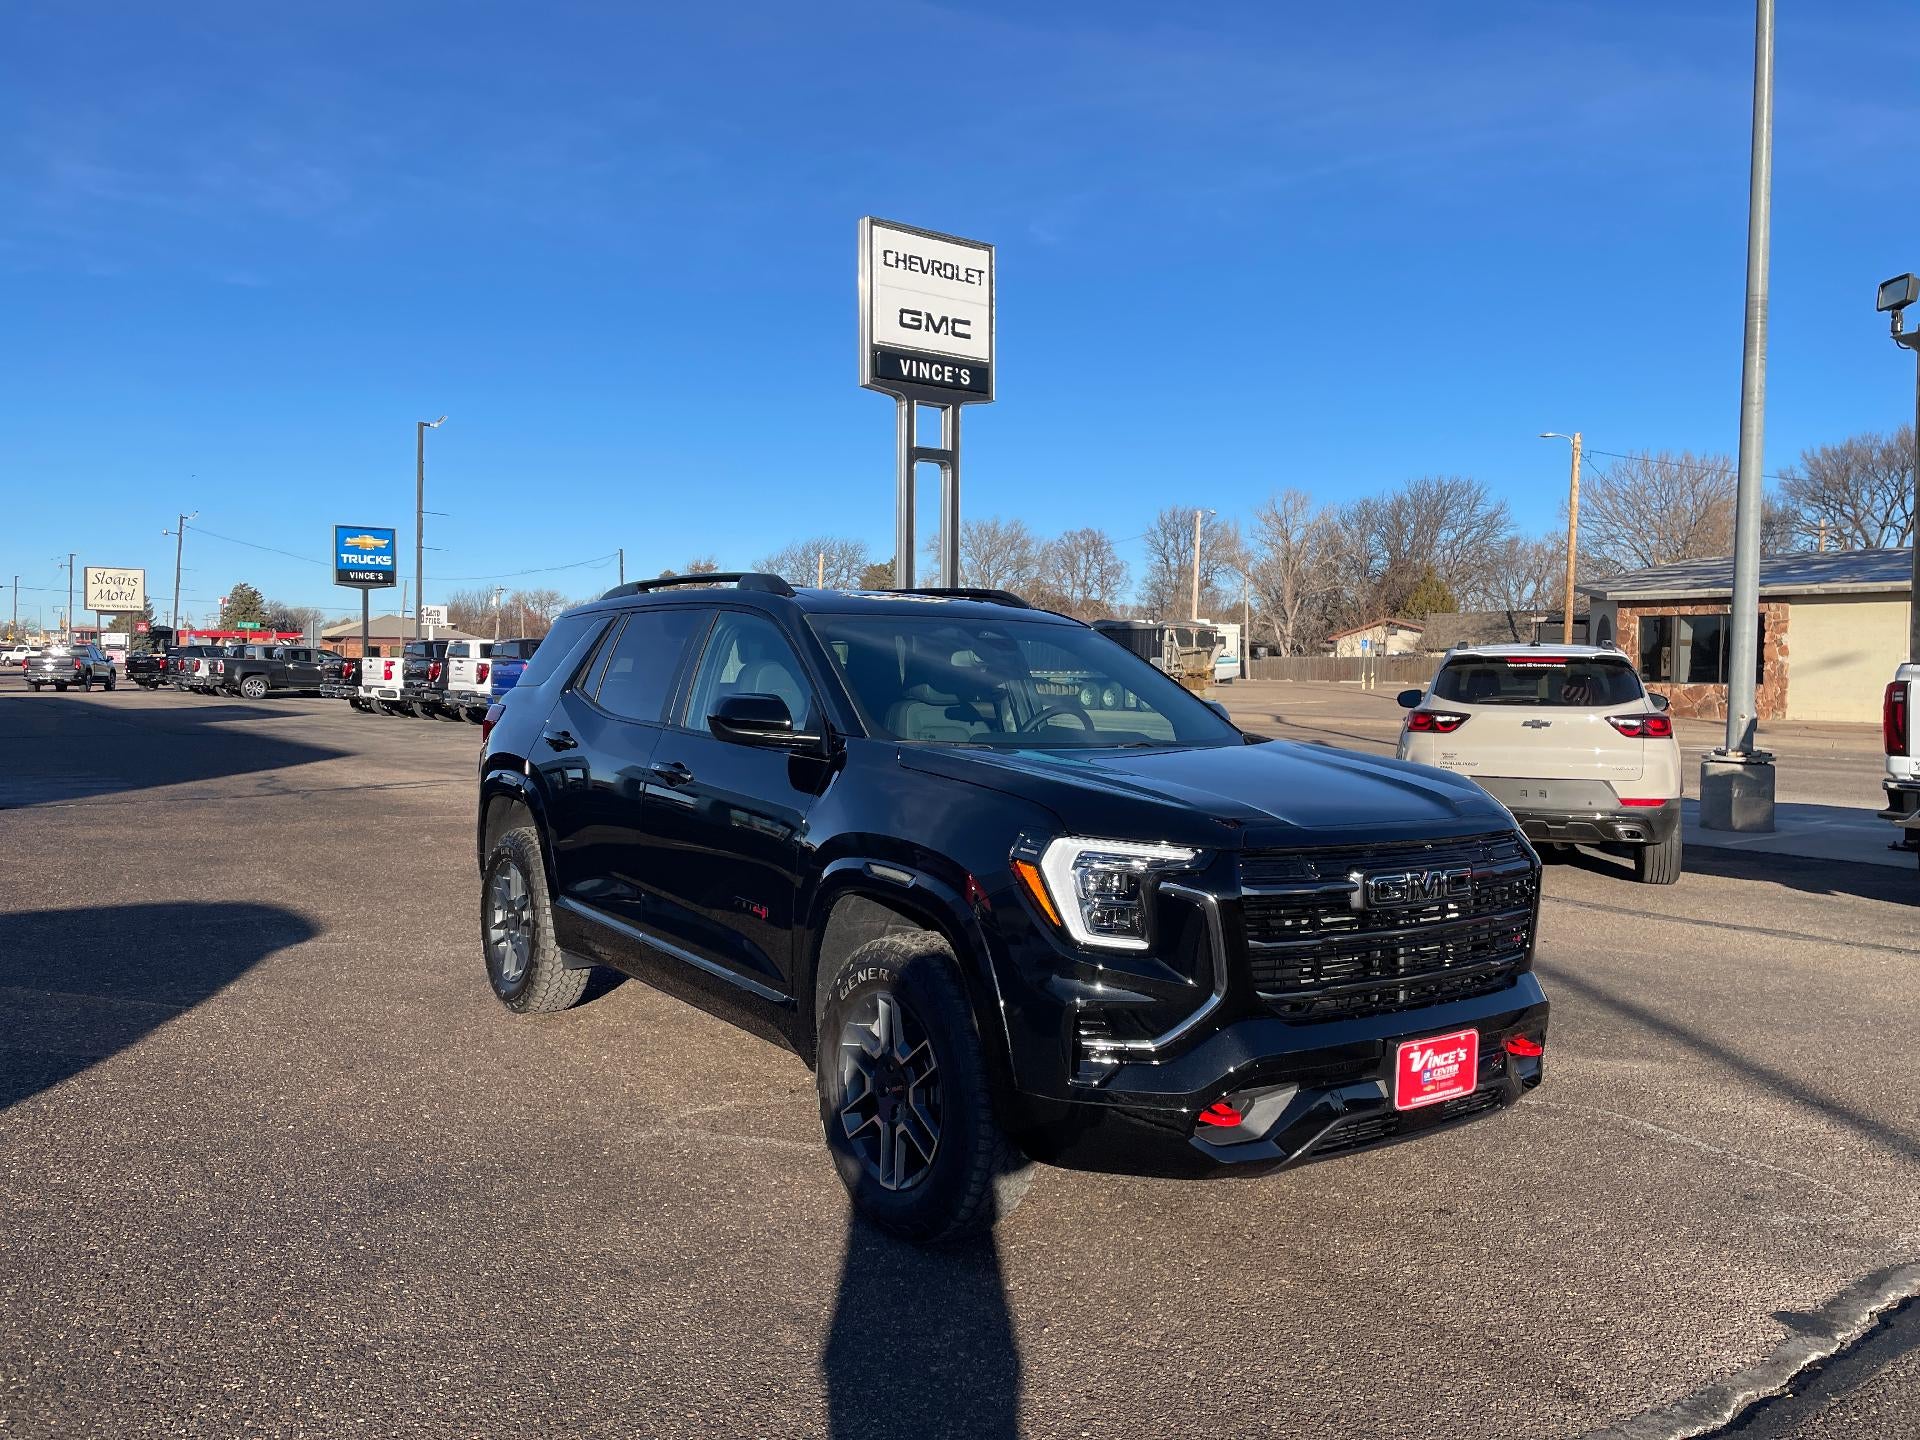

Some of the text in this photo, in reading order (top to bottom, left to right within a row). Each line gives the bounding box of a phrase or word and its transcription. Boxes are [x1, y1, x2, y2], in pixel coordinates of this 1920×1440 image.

[883, 249, 984, 286] CHEVROLET
[899, 308, 971, 339] GMC
[899, 358, 971, 385] VINCE'S
[341, 553, 392, 566] TRUCKS
[92, 571, 139, 586] Sloans
[349, 571, 384, 580] VINCE'S
[93, 588, 136, 601] Motel
[1368, 867, 1472, 905] GMC
[1433, 1064, 1460, 1077] CENTER
